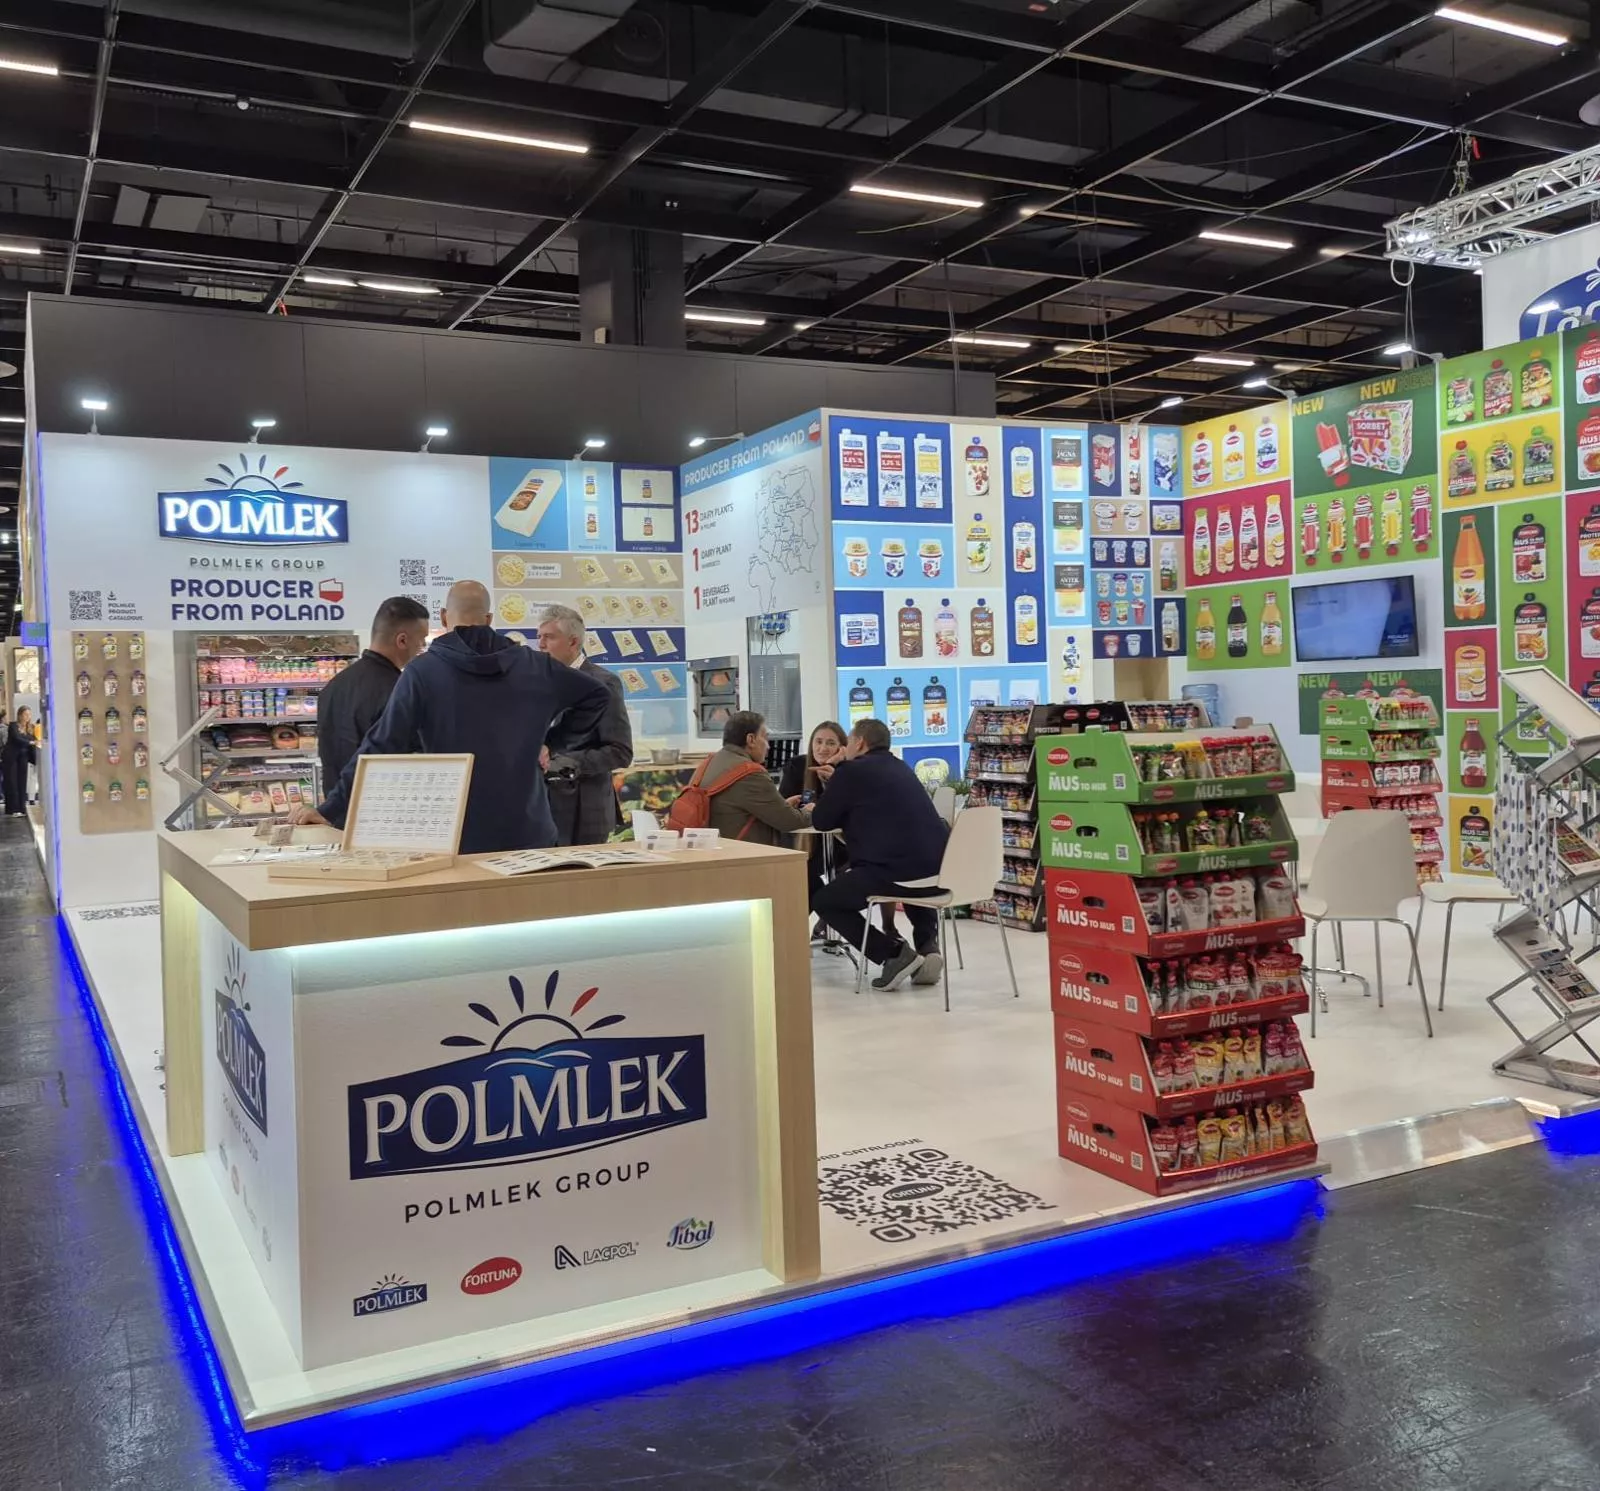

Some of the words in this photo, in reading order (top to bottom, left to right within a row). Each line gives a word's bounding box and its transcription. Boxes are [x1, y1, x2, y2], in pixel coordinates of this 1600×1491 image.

[1360, 378, 1396, 400] NEW
[1293, 396, 1324, 416] NEW
[1357, 422, 1386, 431] SORBET
[685, 457, 730, 487] PRODUCER
[731, 448, 760, 471] FROM
[762, 430, 805, 460] POLAND
[164, 497, 339, 537] POLMLEK
[685, 510, 699, 534] 13
[714, 502, 734, 516] PLANTS
[190, 557, 264, 569] POLMLEK
[271, 559, 325, 569] GROUP
[692, 547, 699, 571] 1
[171, 579, 314, 599] PRODUCER
[693, 586, 700, 610] 1
[172, 603, 243, 620] FROM
[251, 604, 345, 620] POLAND
[1299, 674, 1330, 688] NEW
[1367, 672, 1402, 687] NEW
[1049, 776, 1079, 791] MUS
[1194, 785, 1224, 800] MUS
[1051, 842, 1082, 858] MUS
[1198, 855, 1227, 871] MUS
[1056, 886, 1077, 895] FORTUNA
[1057, 908, 1088, 927] MUS
[1089, 920, 1099, 929] TO
[1099, 921, 1115, 931] MUS
[1205, 933, 1235, 949] MUS
[1060, 981, 1091, 1002] MUS
[1092, 996, 1102, 1005] TO
[1102, 998, 1119, 1009] MUS
[1209, 1012, 1238, 1028] MUS
[217, 1001, 264, 1119] POLMLEK
[1065, 1056, 1096, 1078] MUS
[1097, 1072, 1107, 1081] TO
[1107, 1076, 1123, 1087] MUS
[363, 1050, 689, 1165] POLMLEK
[1213, 1090, 1243, 1106] MUS
[842, 1138, 924, 1157] CATALOGUE
[1067, 1130, 1098, 1153] MUS
[1098, 1147, 1109, 1157] TO
[1109, 1153, 1124, 1164] MUS
[1216, 1167, 1245, 1183] MUS
[405, 1181, 541, 1223] POLMLEK
[555, 1161, 651, 1195] GROUP
[886, 1183, 938, 1200] FORTUNA
[667, 1220, 713, 1250] Jibal
[583, 1242, 635, 1266] LACPOL
[464, 1267, 518, 1289] FORTUNA
[356, 1286, 423, 1314] POLMLEK
